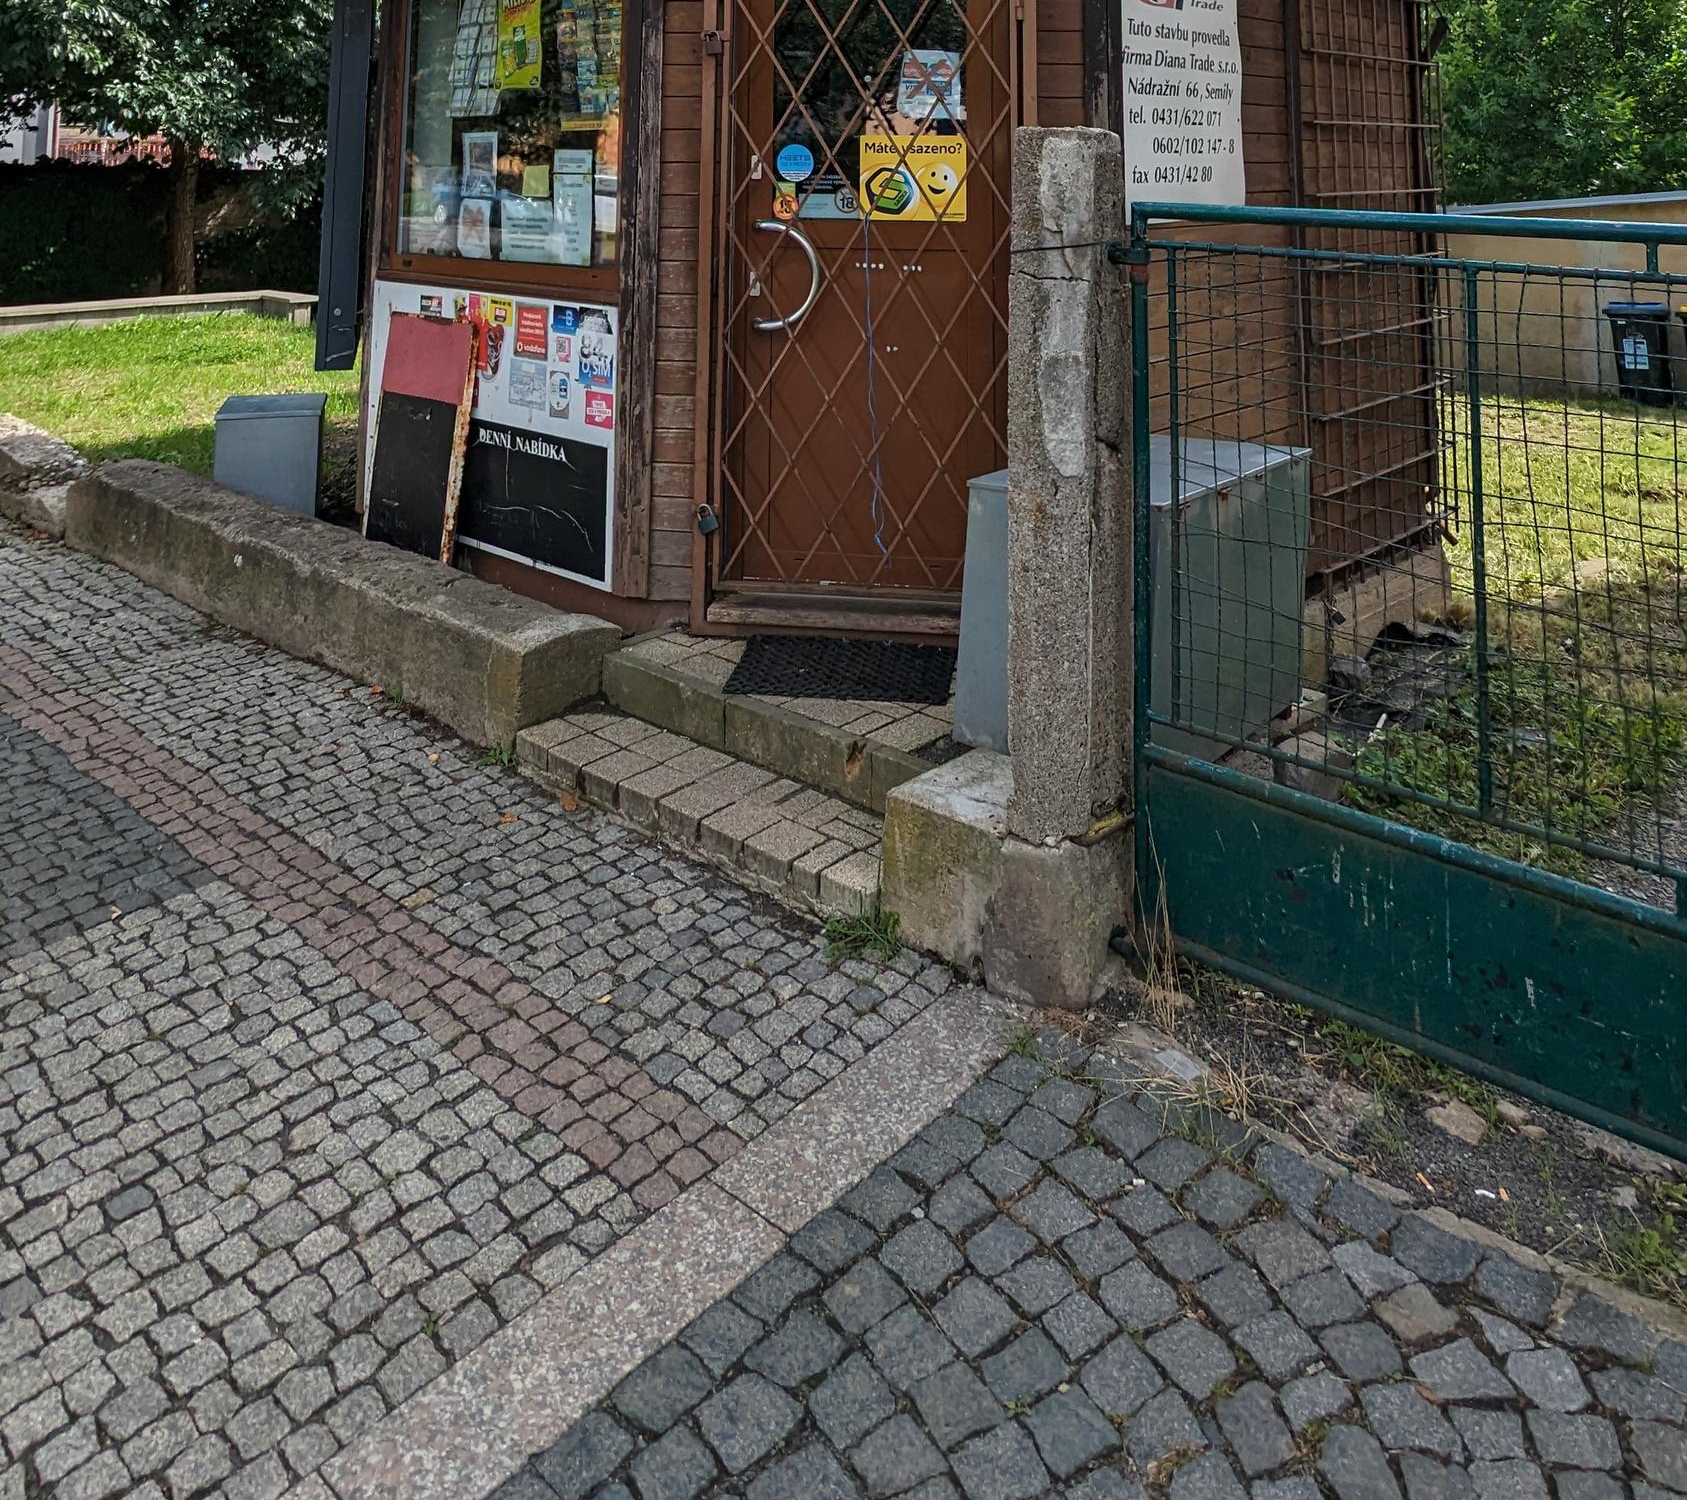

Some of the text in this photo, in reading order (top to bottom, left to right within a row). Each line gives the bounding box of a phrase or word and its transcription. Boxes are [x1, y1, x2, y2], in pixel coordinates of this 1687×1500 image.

[1127, 18, 1230, 48] Tuto stavbu provedla
[1120, 45, 1239, 74] firma Diana Trade s.r.o.
[1128, 76, 1181, 97] Nádražní
[1205, 83, 1234, 105] Semily
[1129, 105, 1222, 128] tel. 0431/622 071
[864, 142, 895, 154] Máte
[1152, 136, 1204, 157] 0602/102
[1132, 164, 1213, 186] fax 0431/42 80
[840, 196, 854, 209] 18
[592, 362, 611, 377] SIM
[479, 427, 567, 462] DENNÍ NABÍDKA
